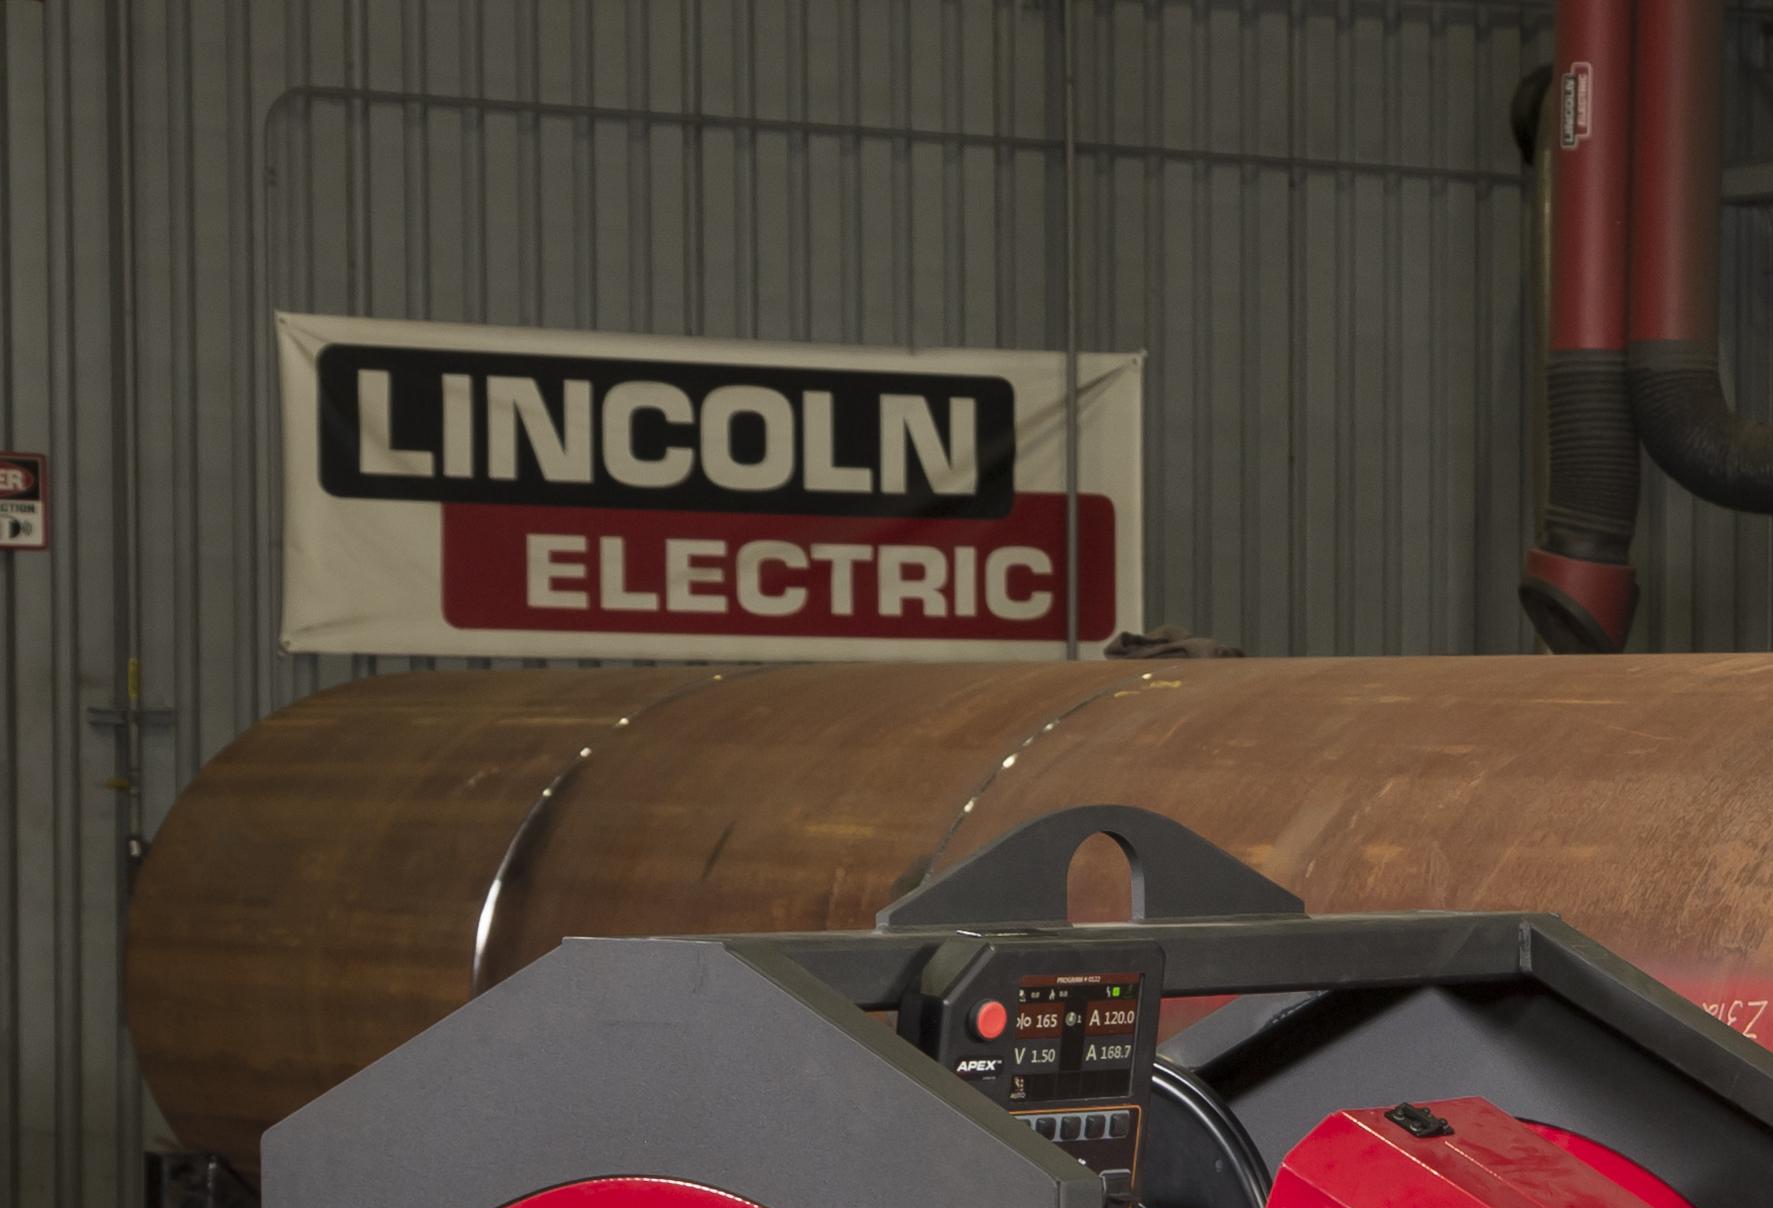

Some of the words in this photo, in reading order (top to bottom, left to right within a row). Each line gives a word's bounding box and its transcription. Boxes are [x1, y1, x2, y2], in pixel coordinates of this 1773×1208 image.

[357, 369, 978, 495] LINCOLN
[527, 532, 1053, 621] ELECTRIC
[1036, 1014, 1058, 1028] 165
[1089, 1009, 1101, 1027] A
[1104, 1010, 1135, 1025] 120.0
[1015, 1047, 1026, 1065] V
[1031, 1049, 1056, 1063] 1.50
[1086, 1044, 1097, 1062] A
[1101, 1045, 1132, 1060] 168.7
